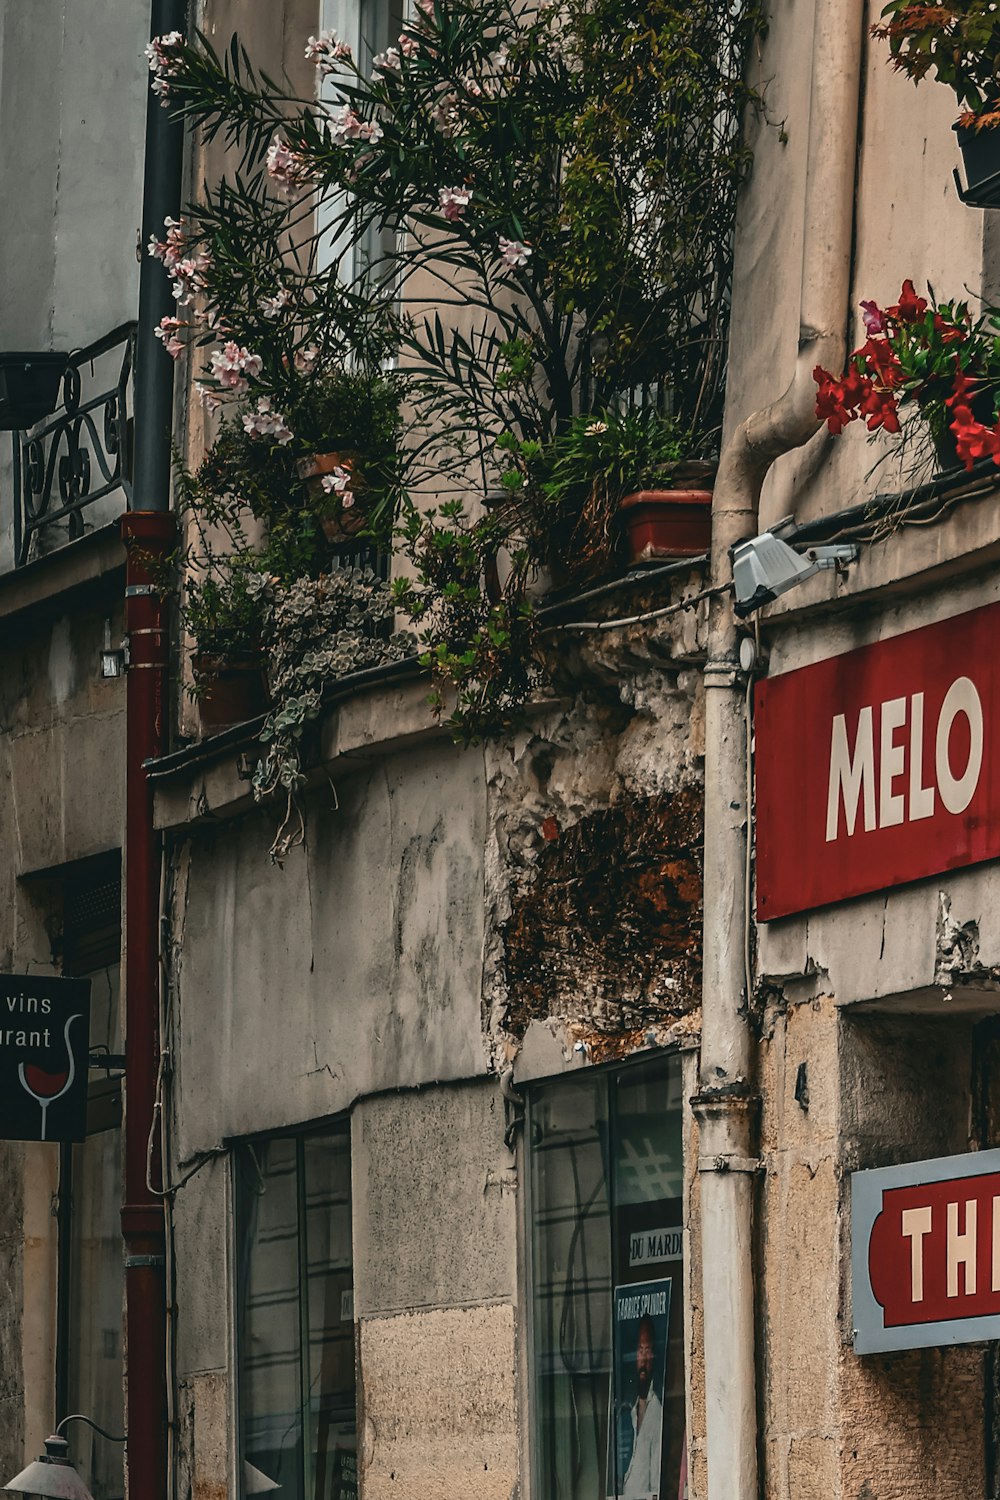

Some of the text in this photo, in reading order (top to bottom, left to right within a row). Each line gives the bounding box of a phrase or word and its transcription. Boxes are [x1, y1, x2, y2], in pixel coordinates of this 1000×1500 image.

[825, 676, 984, 842] MELO
[6, 993, 51, 1014] vins
[632, 1238, 643, 1260] DU
